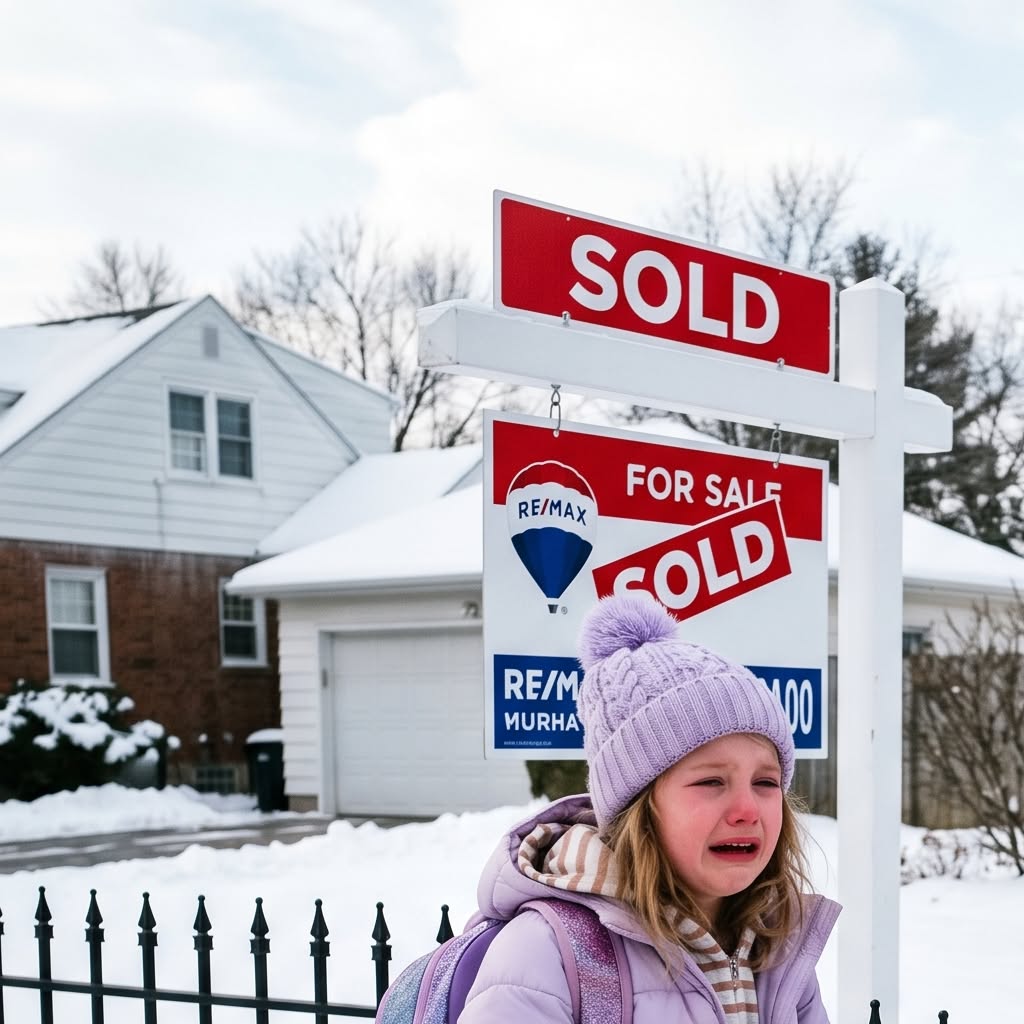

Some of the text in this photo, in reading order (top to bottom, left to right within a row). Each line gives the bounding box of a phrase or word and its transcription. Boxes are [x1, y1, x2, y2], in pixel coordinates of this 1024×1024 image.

[569, 234, 780, 345] SOLD
[627, 463, 694, 504] FOR
[518, 498, 587, 526] RE/MAX
